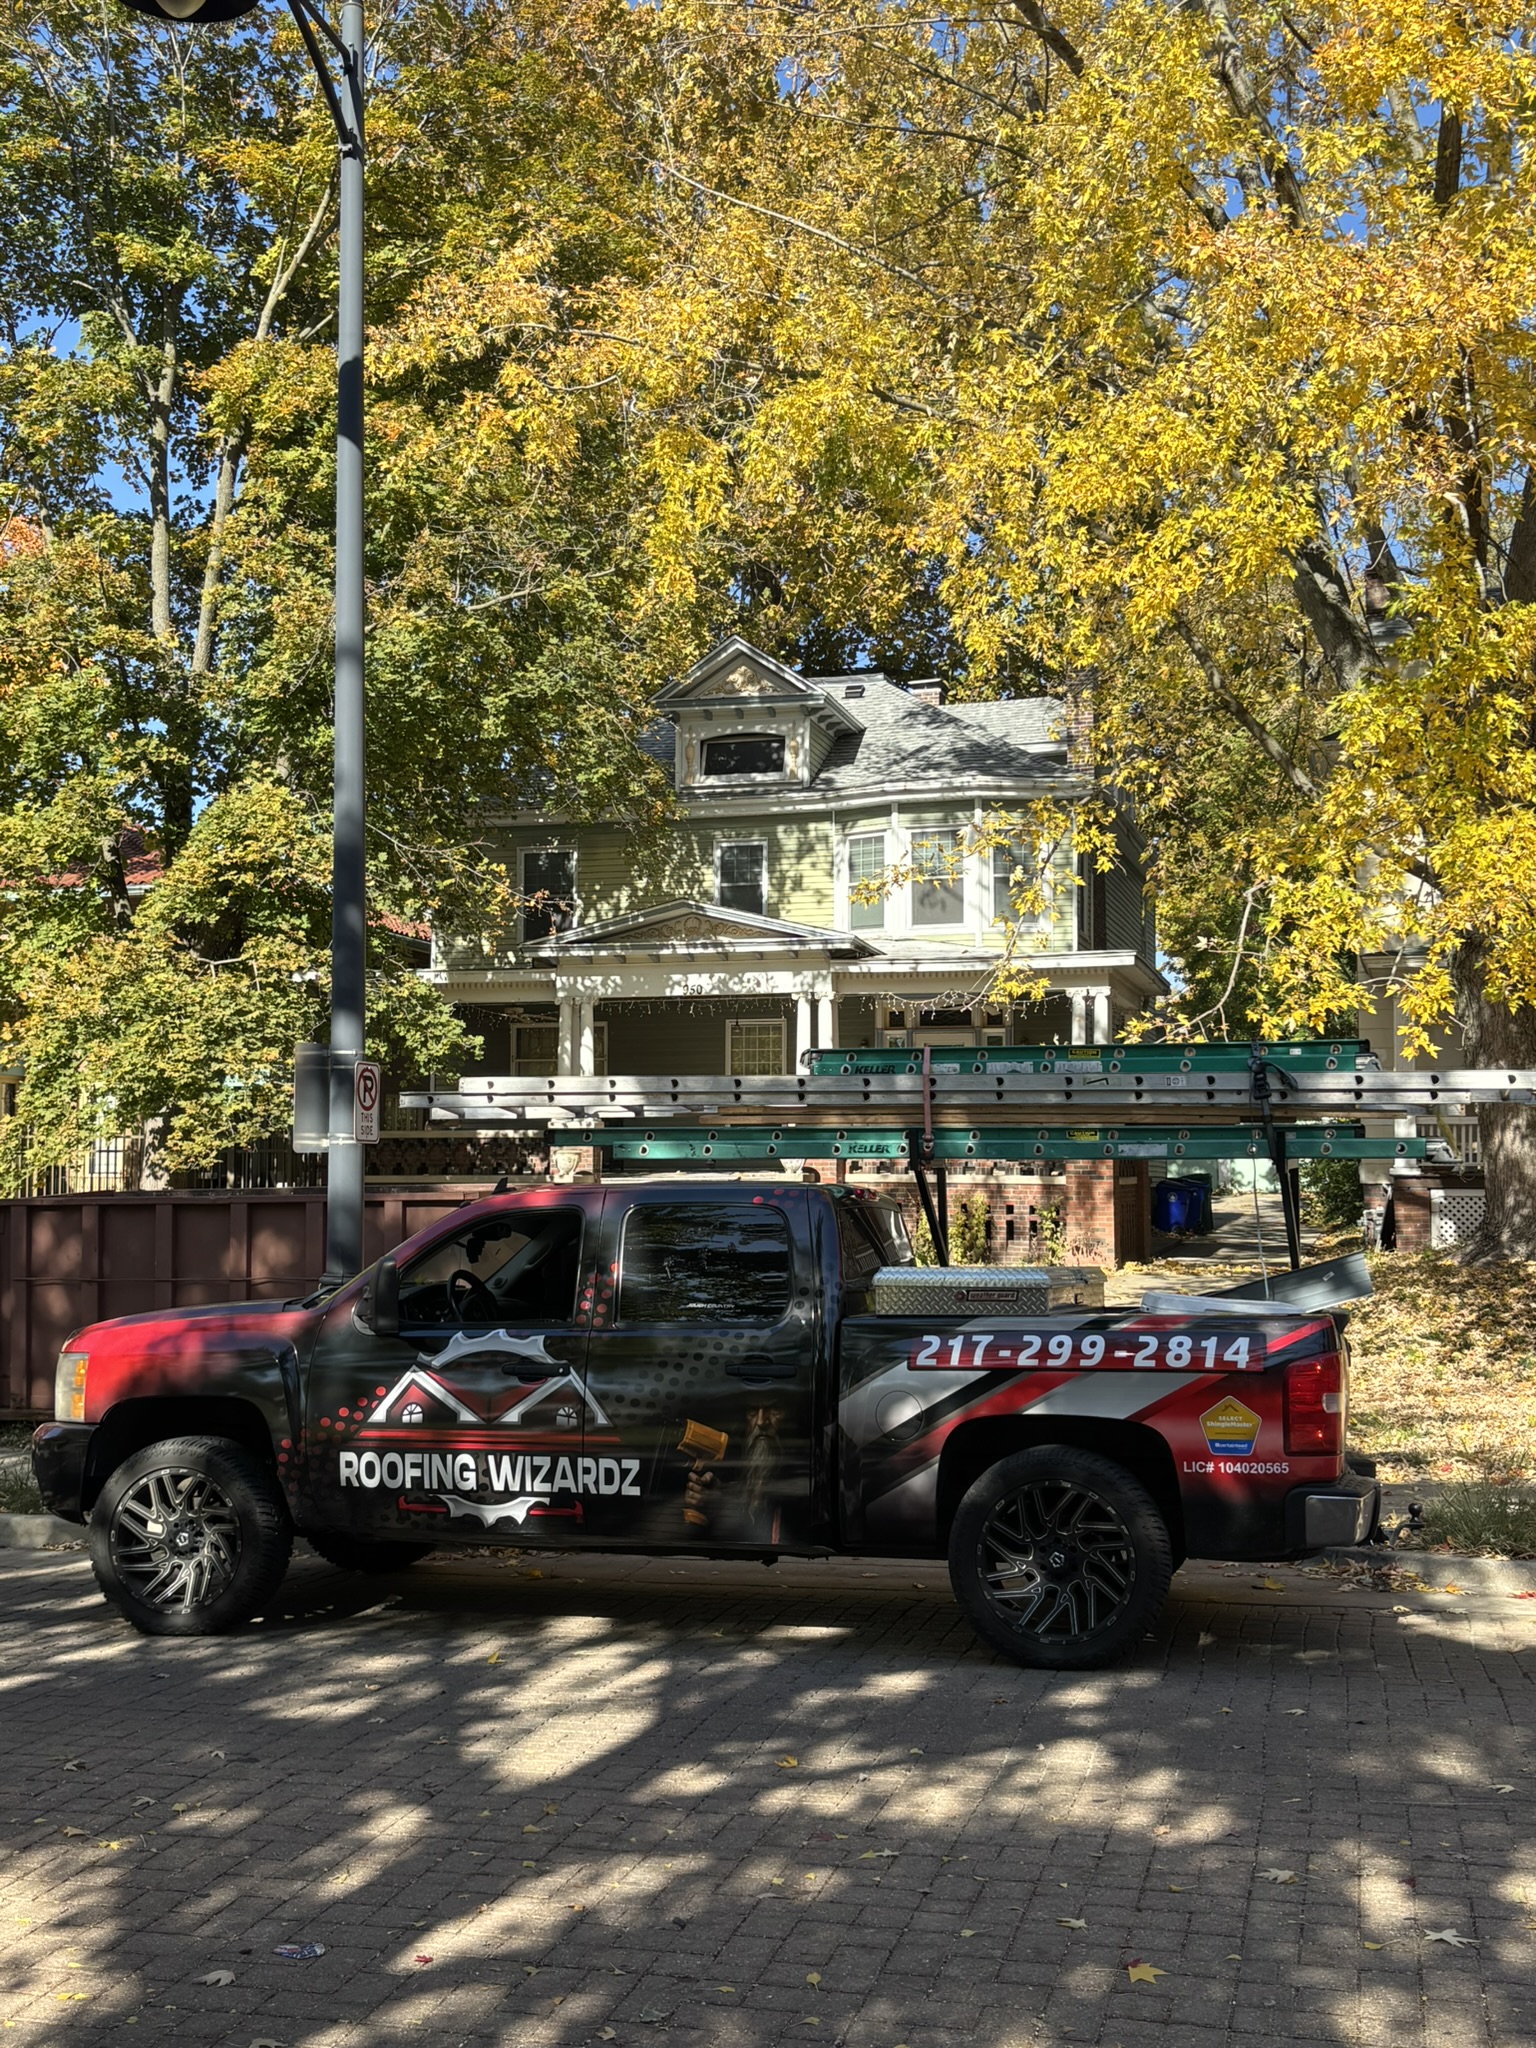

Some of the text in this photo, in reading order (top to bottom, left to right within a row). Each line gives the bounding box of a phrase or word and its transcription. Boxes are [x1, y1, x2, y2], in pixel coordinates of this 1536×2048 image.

[682, 984, 703, 996] 950
[854, 1064, 897, 1075] KELLER
[361, 1112, 374, 1123] THIS
[360, 1125, 374, 1136] SIDE
[848, 1143, 891, 1154] KELLER
[915, 1334, 1251, 1369] 217-299-2814
[1183, 1461, 1289, 1474] LIC# 104020565
[339, 1451, 641, 1497] ROOFING WIZARDZ
